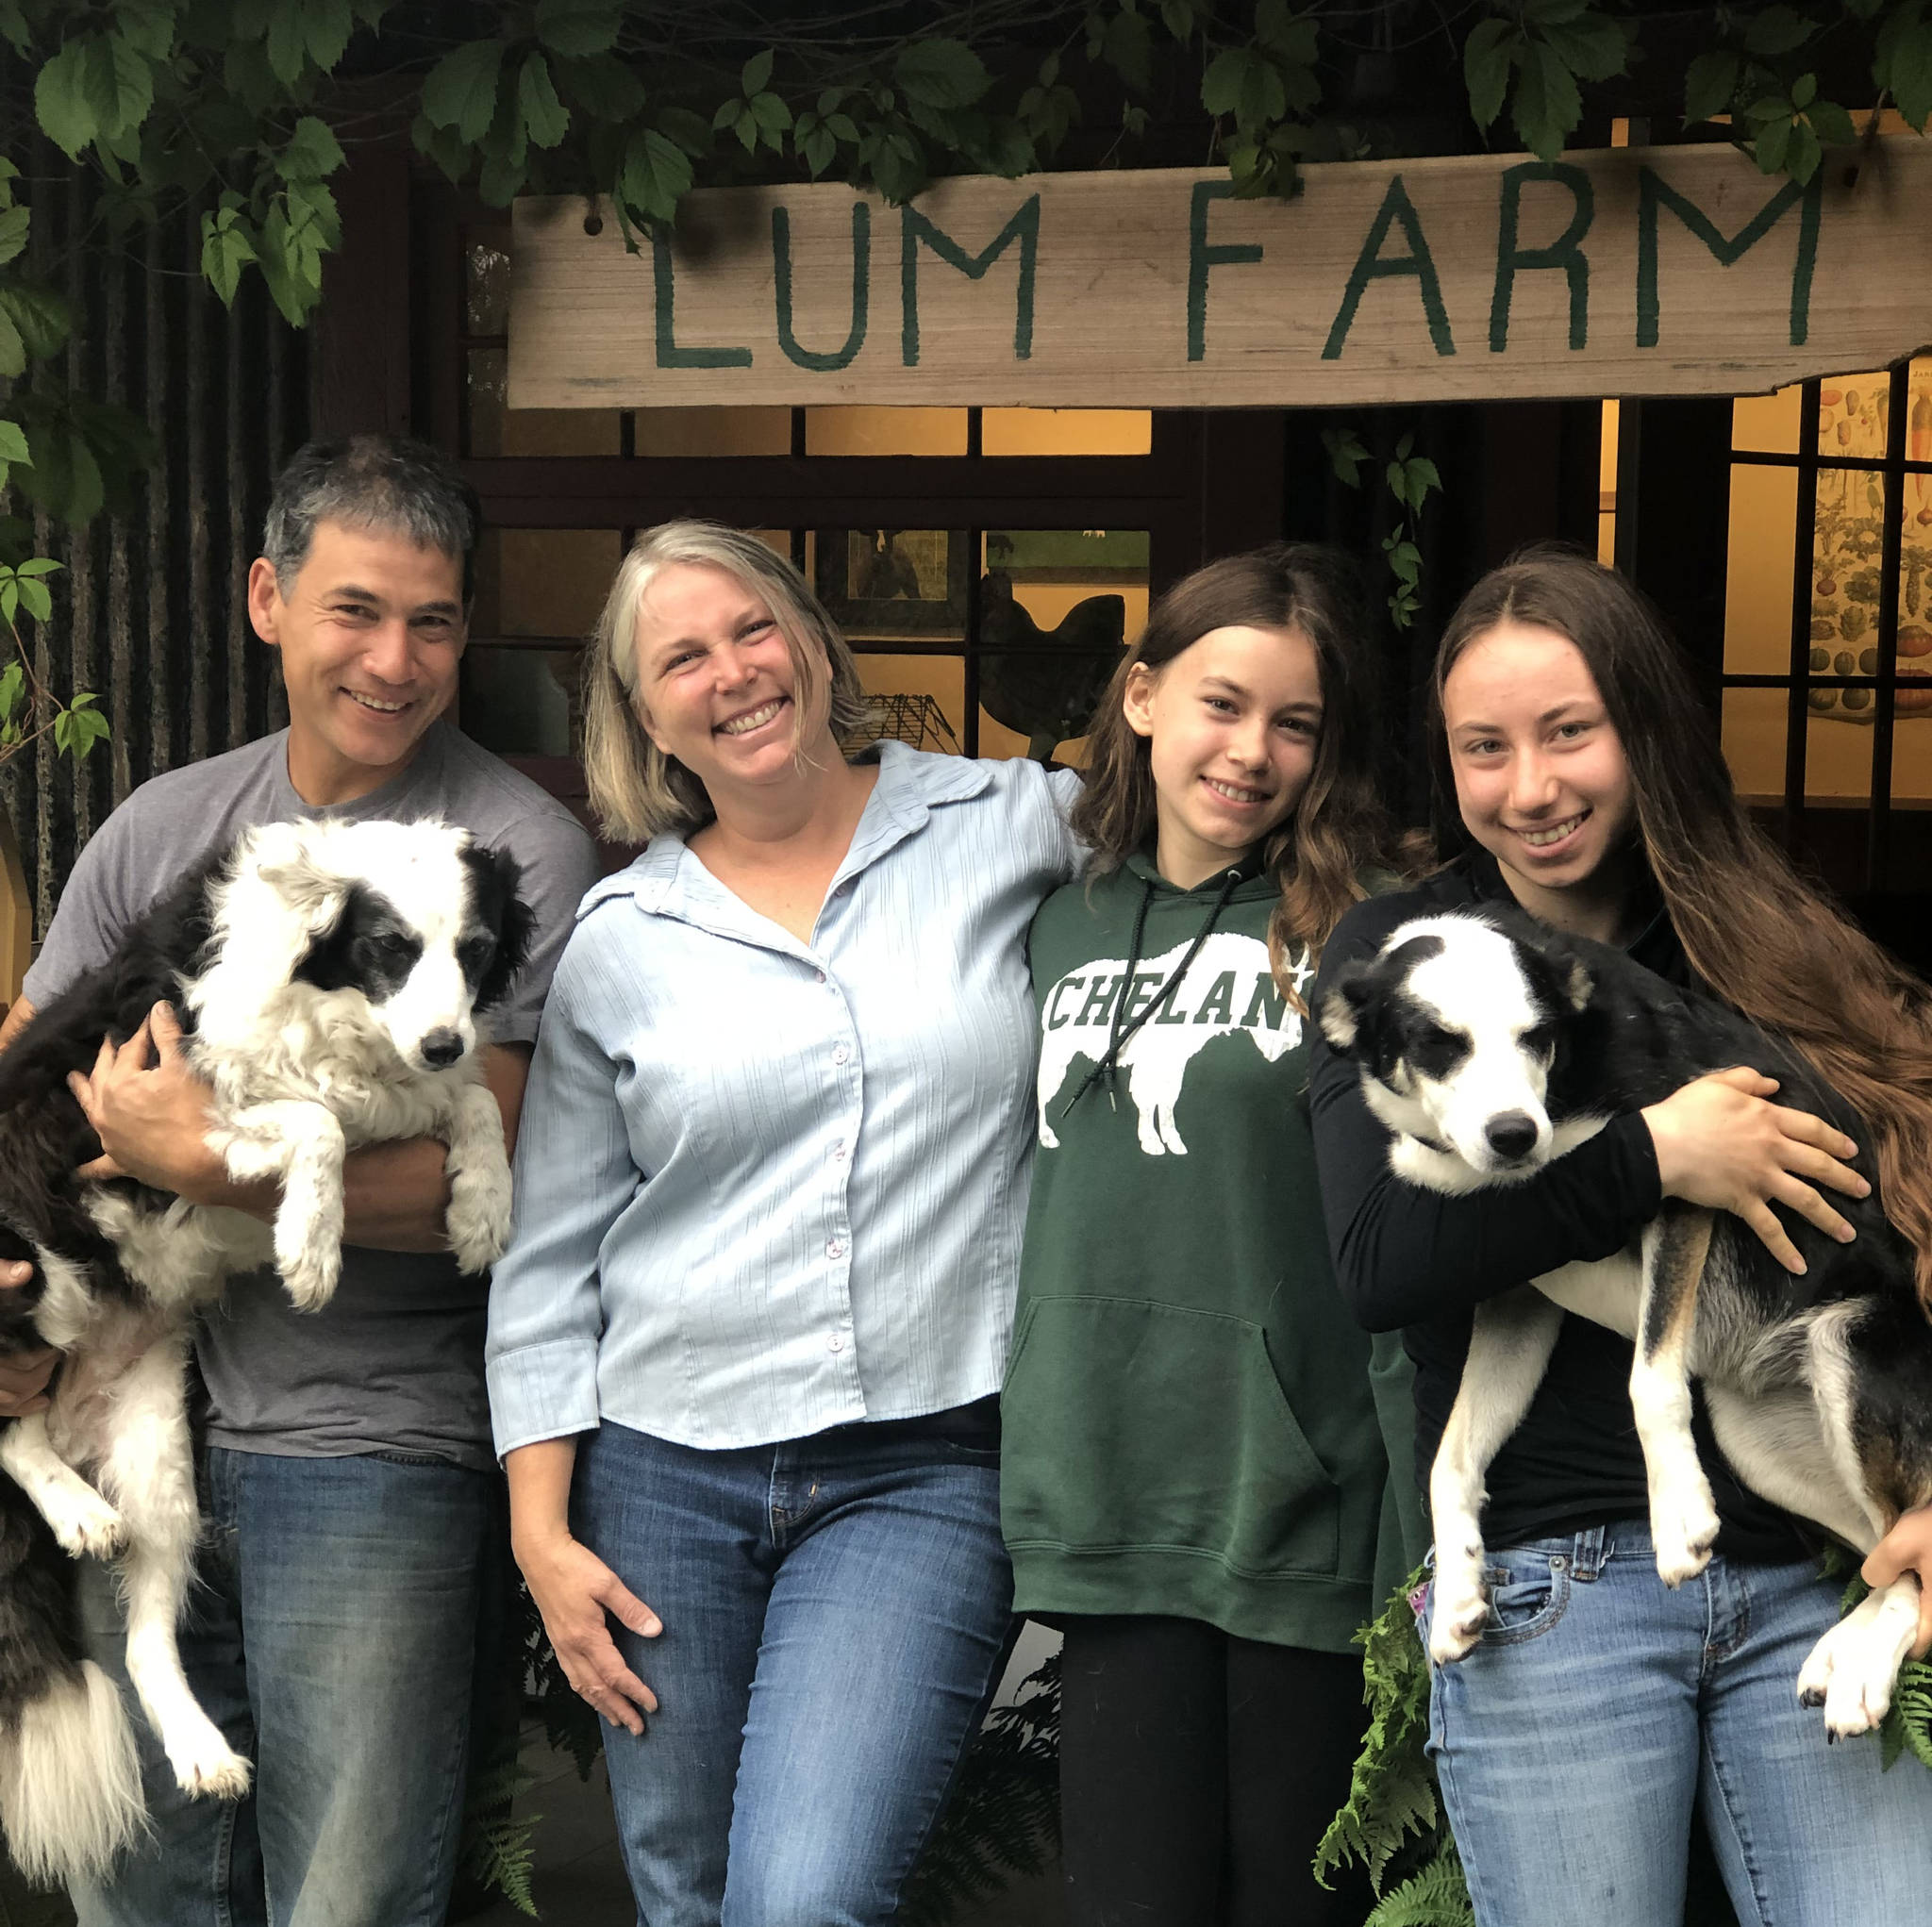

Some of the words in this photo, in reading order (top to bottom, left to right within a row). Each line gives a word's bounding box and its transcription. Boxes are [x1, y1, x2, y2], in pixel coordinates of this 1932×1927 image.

[652, 193, 1040, 372] LUM
[1187, 157, 1824, 361] FARM
[1048, 971, 1299, 1030] CHELAN
